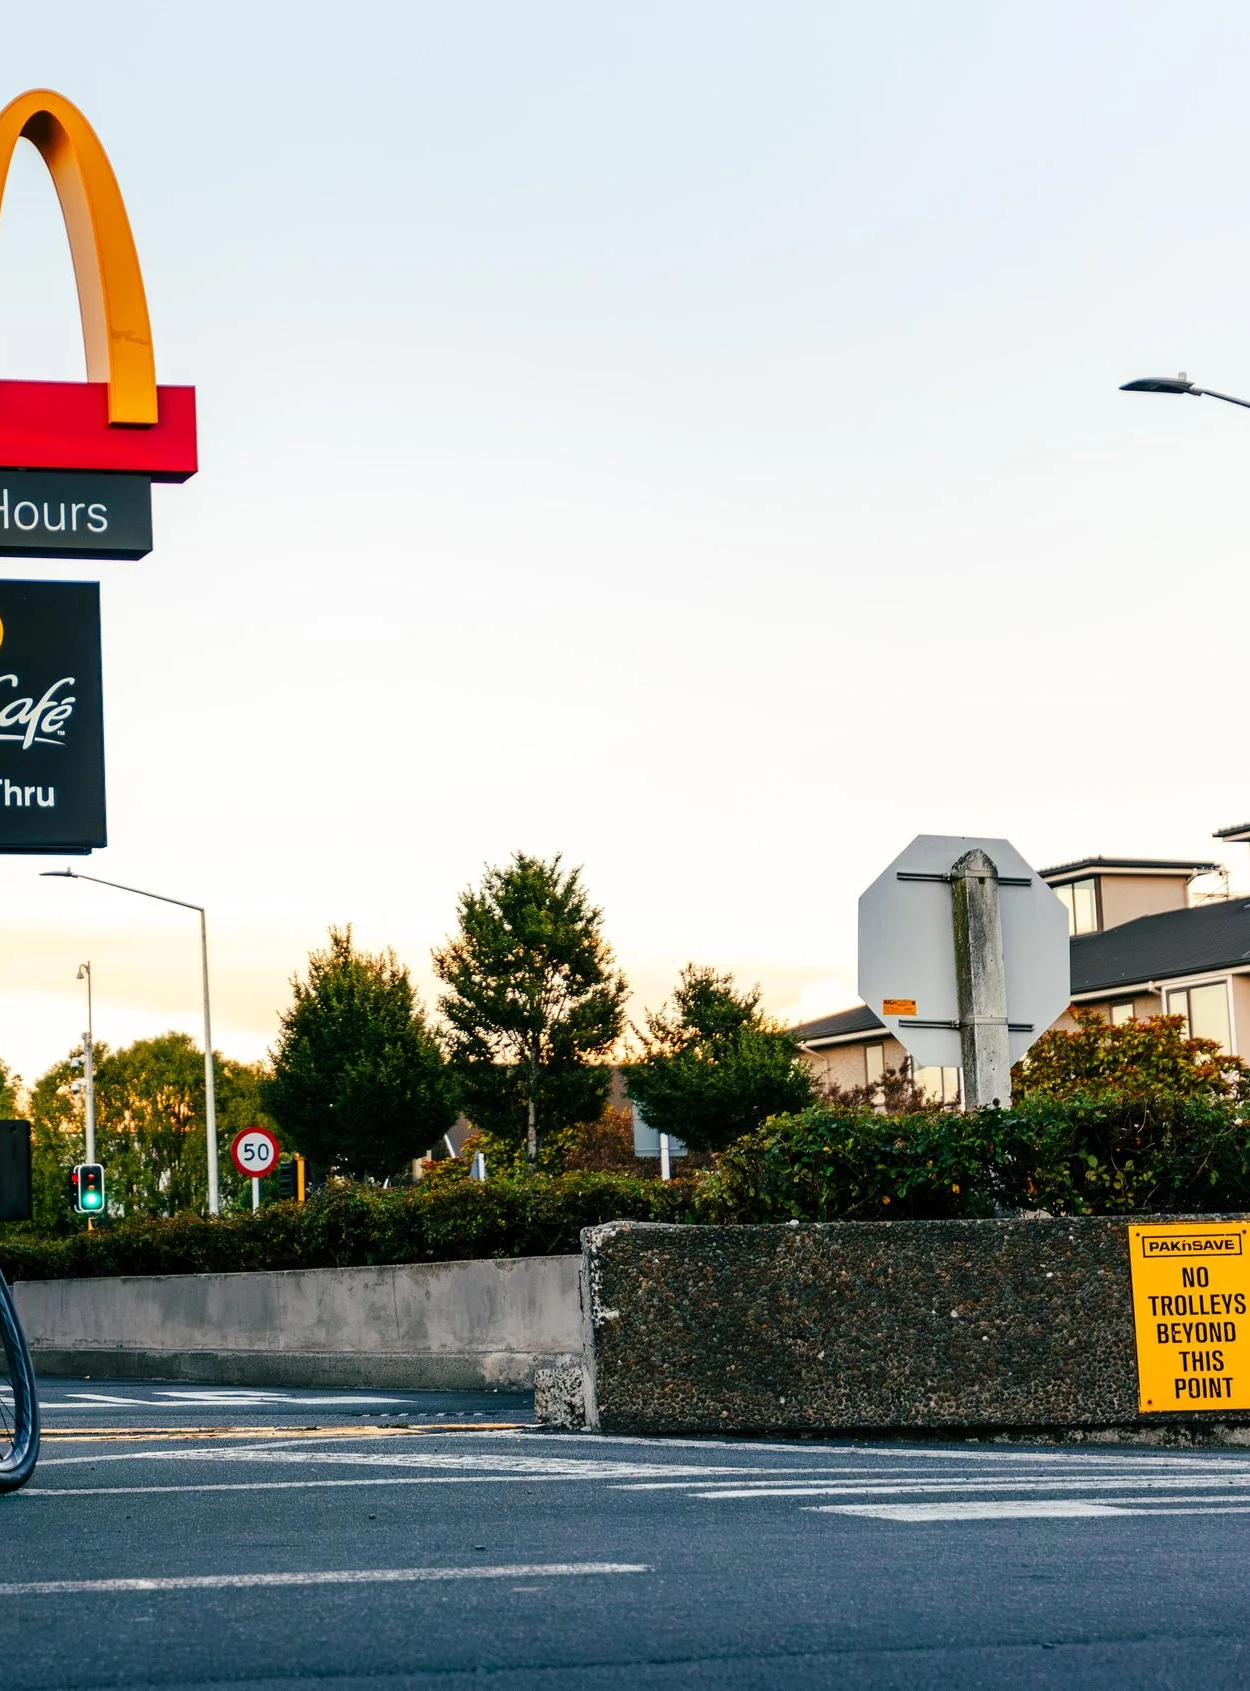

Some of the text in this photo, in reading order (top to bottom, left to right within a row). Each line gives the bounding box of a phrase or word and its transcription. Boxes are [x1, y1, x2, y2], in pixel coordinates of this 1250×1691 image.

[243, 1143, 270, 1161] 50
[1181, 1266, 1210, 1288] NO
[1148, 1293, 1247, 1316] TROLLEYS
[1156, 1321, 1237, 1344] BEYOND
[1179, 1350, 1225, 1372] THIS
[1174, 1377, 1234, 1399] POINT
